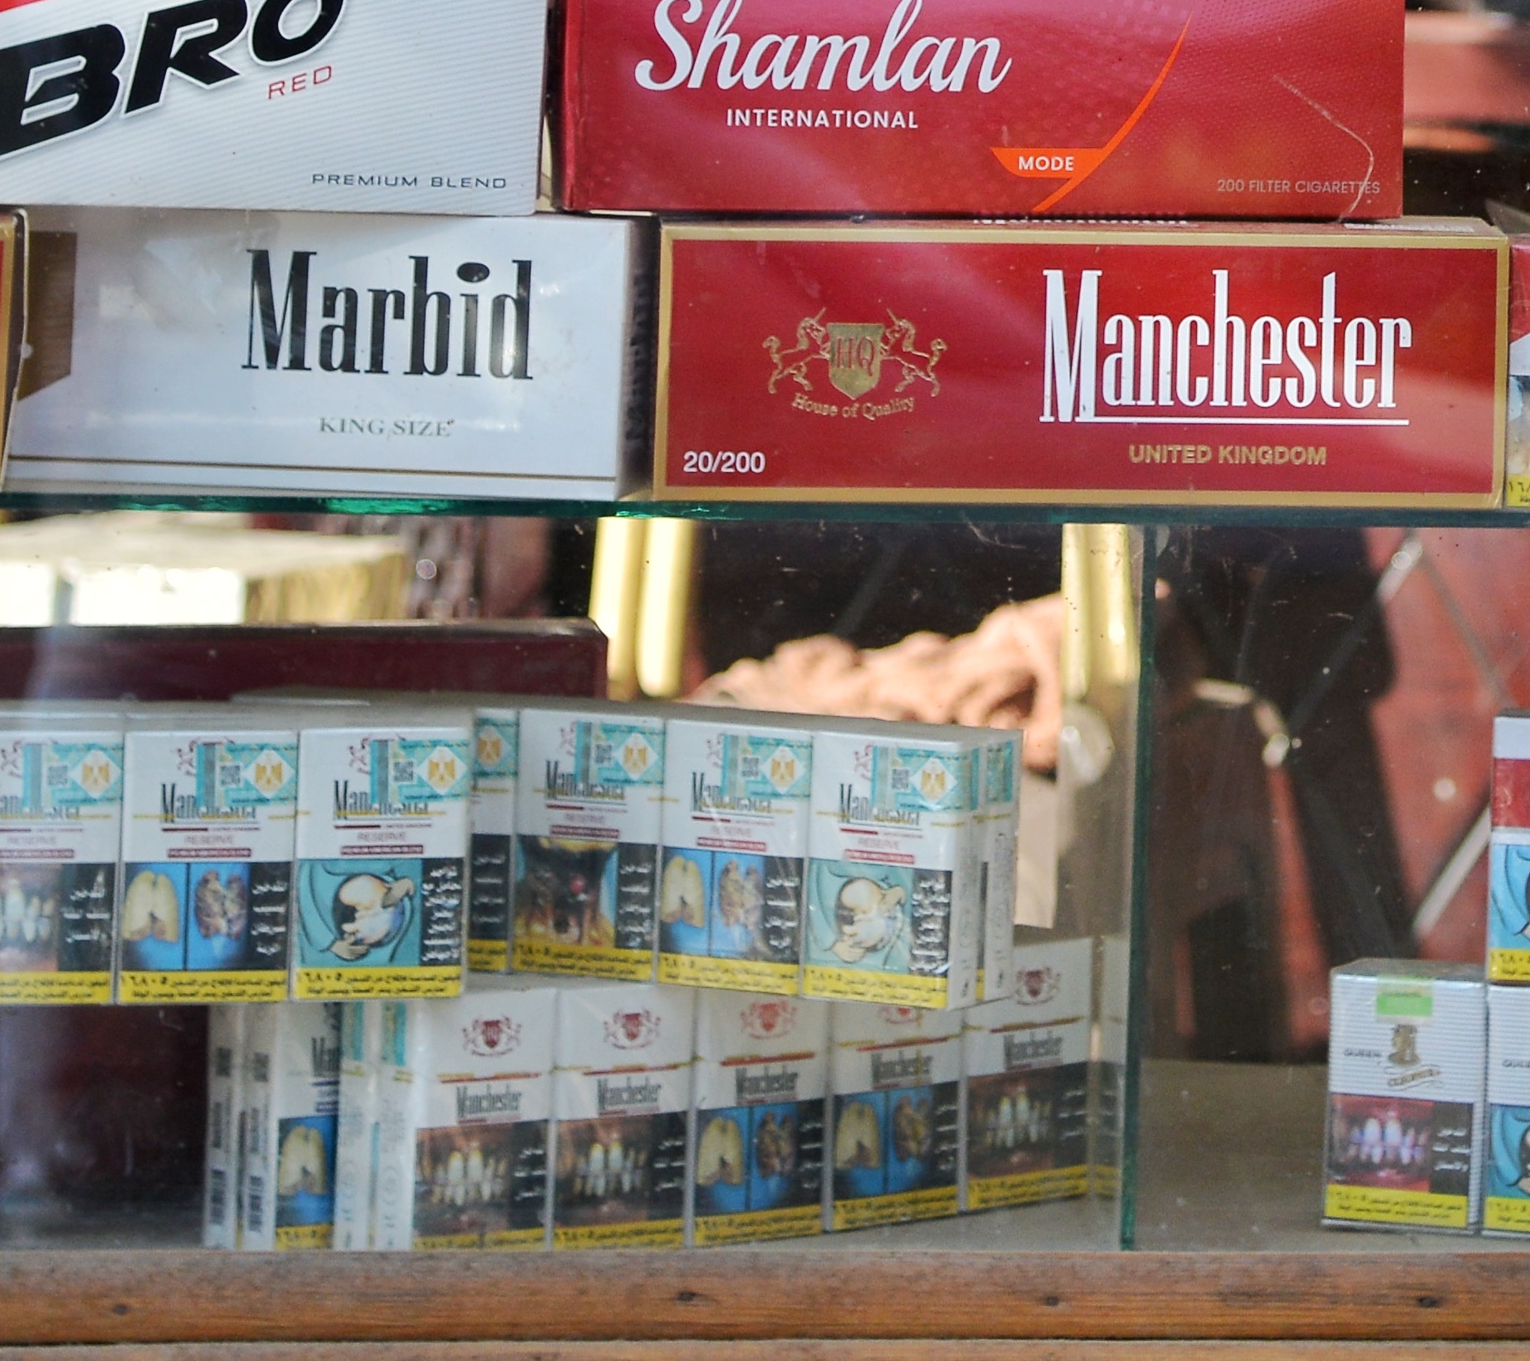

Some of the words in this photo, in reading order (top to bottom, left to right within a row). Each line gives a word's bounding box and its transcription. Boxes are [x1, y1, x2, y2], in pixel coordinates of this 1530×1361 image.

[266, 64, 334, 102] RED
[726, 108, 919, 130] INTERNATIONAL
[1017, 155, 1076, 173] MODE
[311, 172, 420, 188] PREMIUM
[429, 175, 508, 190] BLEND
[1216, 178, 1245, 194] 200
[1247, 179, 1291, 194] FILTER
[1294, 179, 1382, 195] CIGARETTES
[241, 248, 534, 381] Marbid
[837, 334, 876, 378] HQ
[1039, 269, 1412, 426] Manchester
[792, 392, 840, 418] House
[841, 401, 860, 419] of
[861, 395, 916, 421] Quality
[319, 416, 386, 437] KING
[392, 418, 452, 439] SIZE
[682, 450, 766, 476] 20/200
[1128, 444, 1214, 466] UNITED
[1218, 445, 1328, 467] KINGDOM
